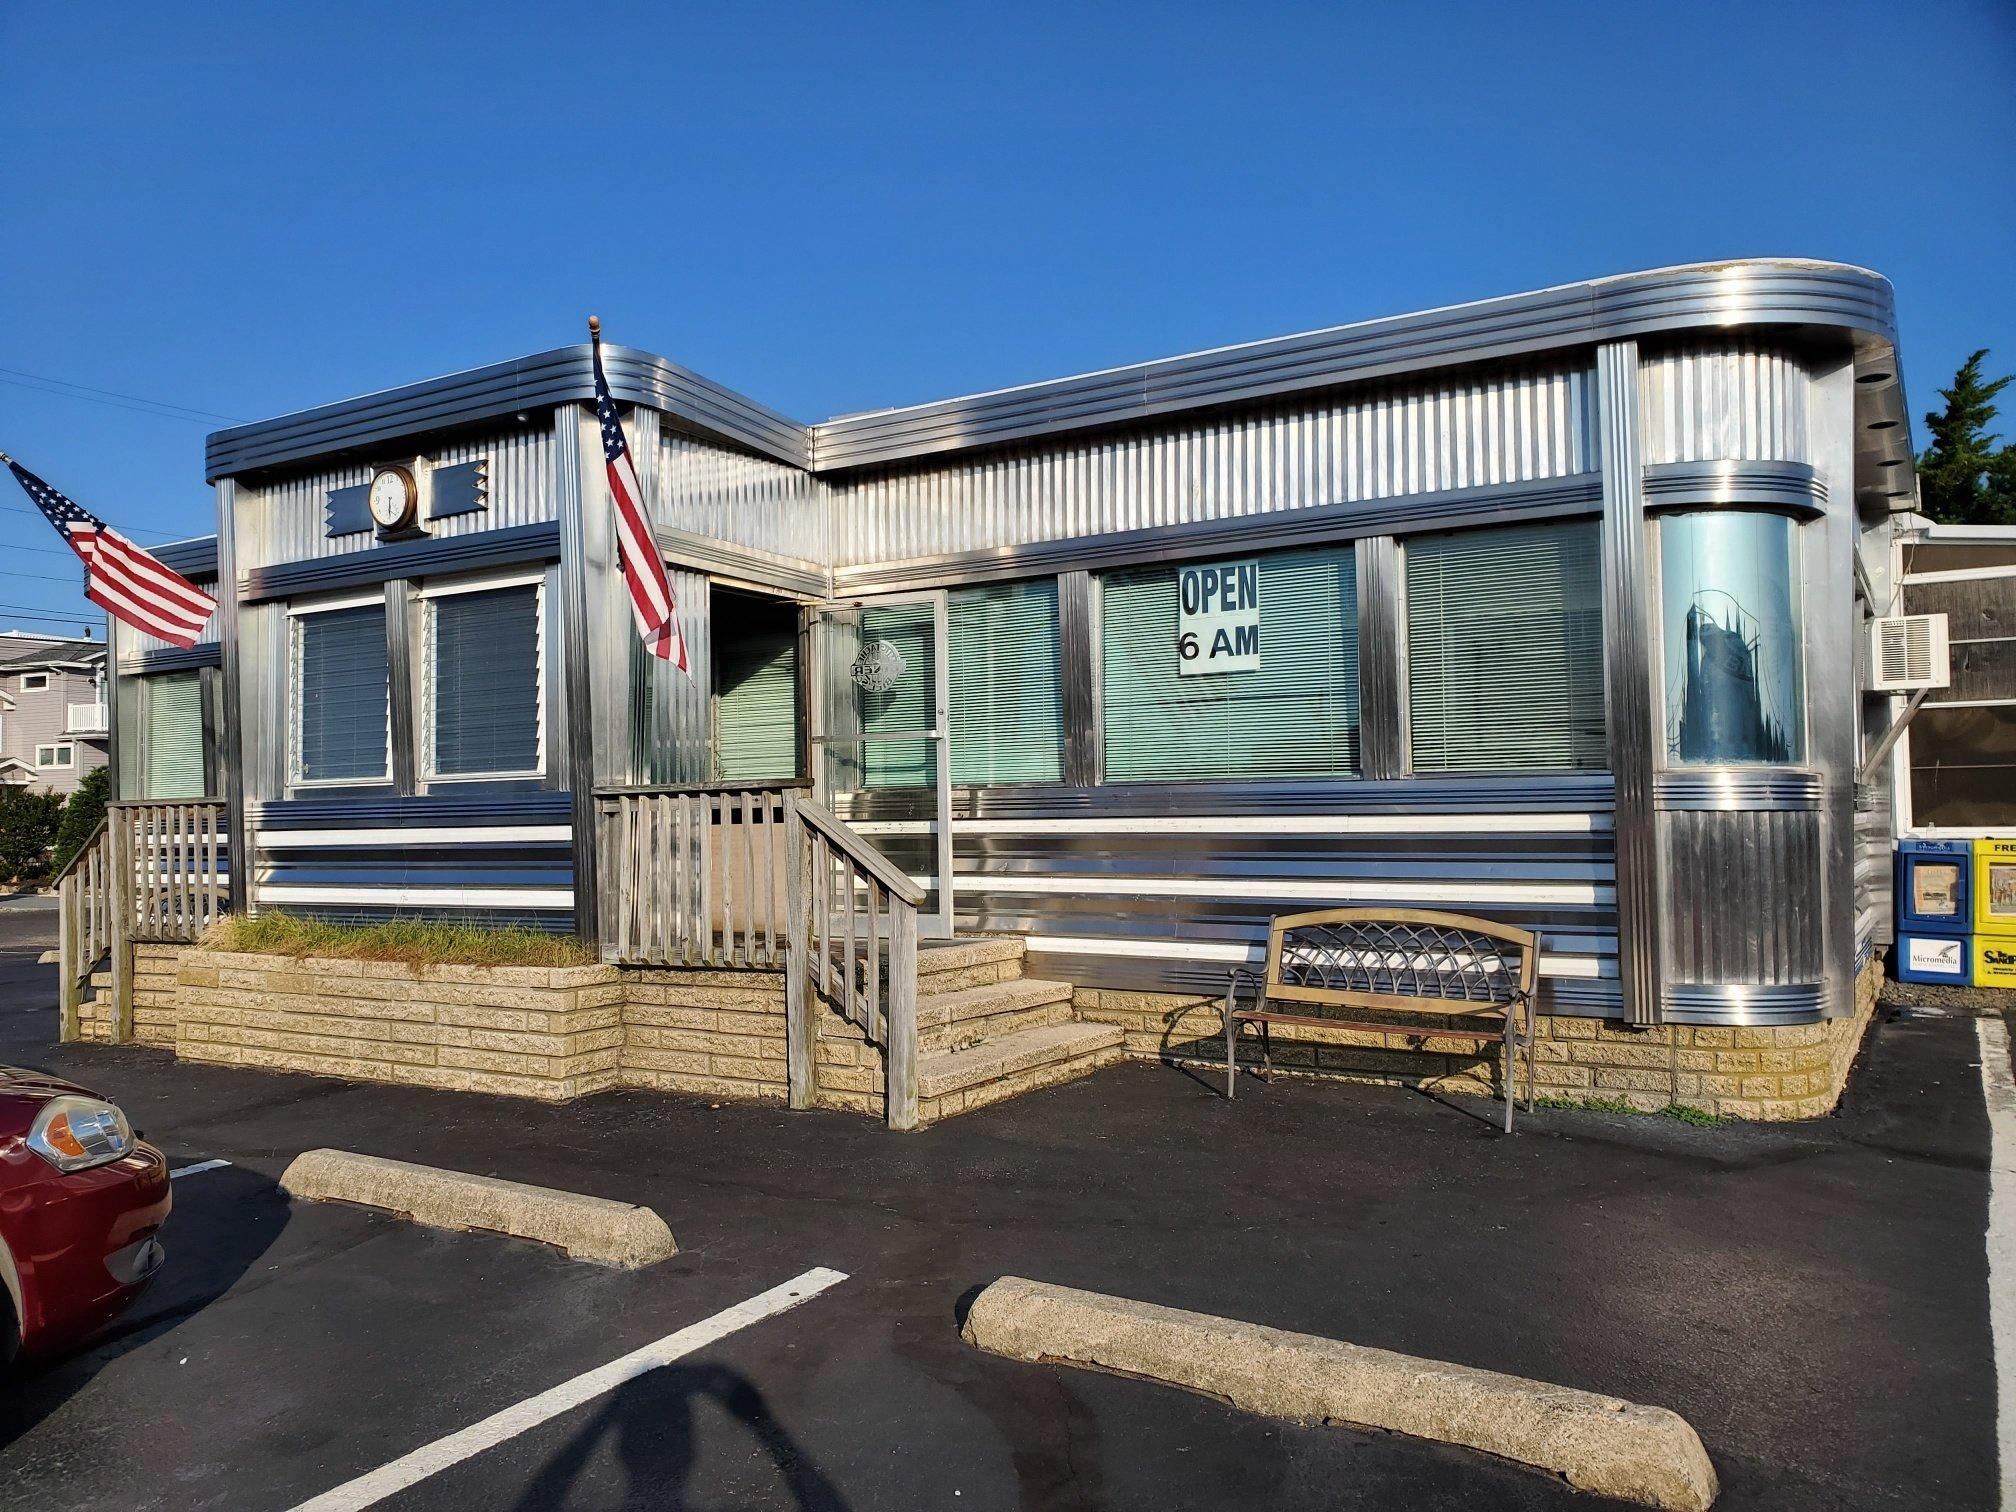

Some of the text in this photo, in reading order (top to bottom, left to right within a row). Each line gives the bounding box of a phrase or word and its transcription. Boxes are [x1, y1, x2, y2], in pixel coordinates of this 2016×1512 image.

[1181, 564, 1257, 616] OPEN
[1180, 625, 1259, 660] 6 AM
[1912, 954, 1957, 965] Micromedia
